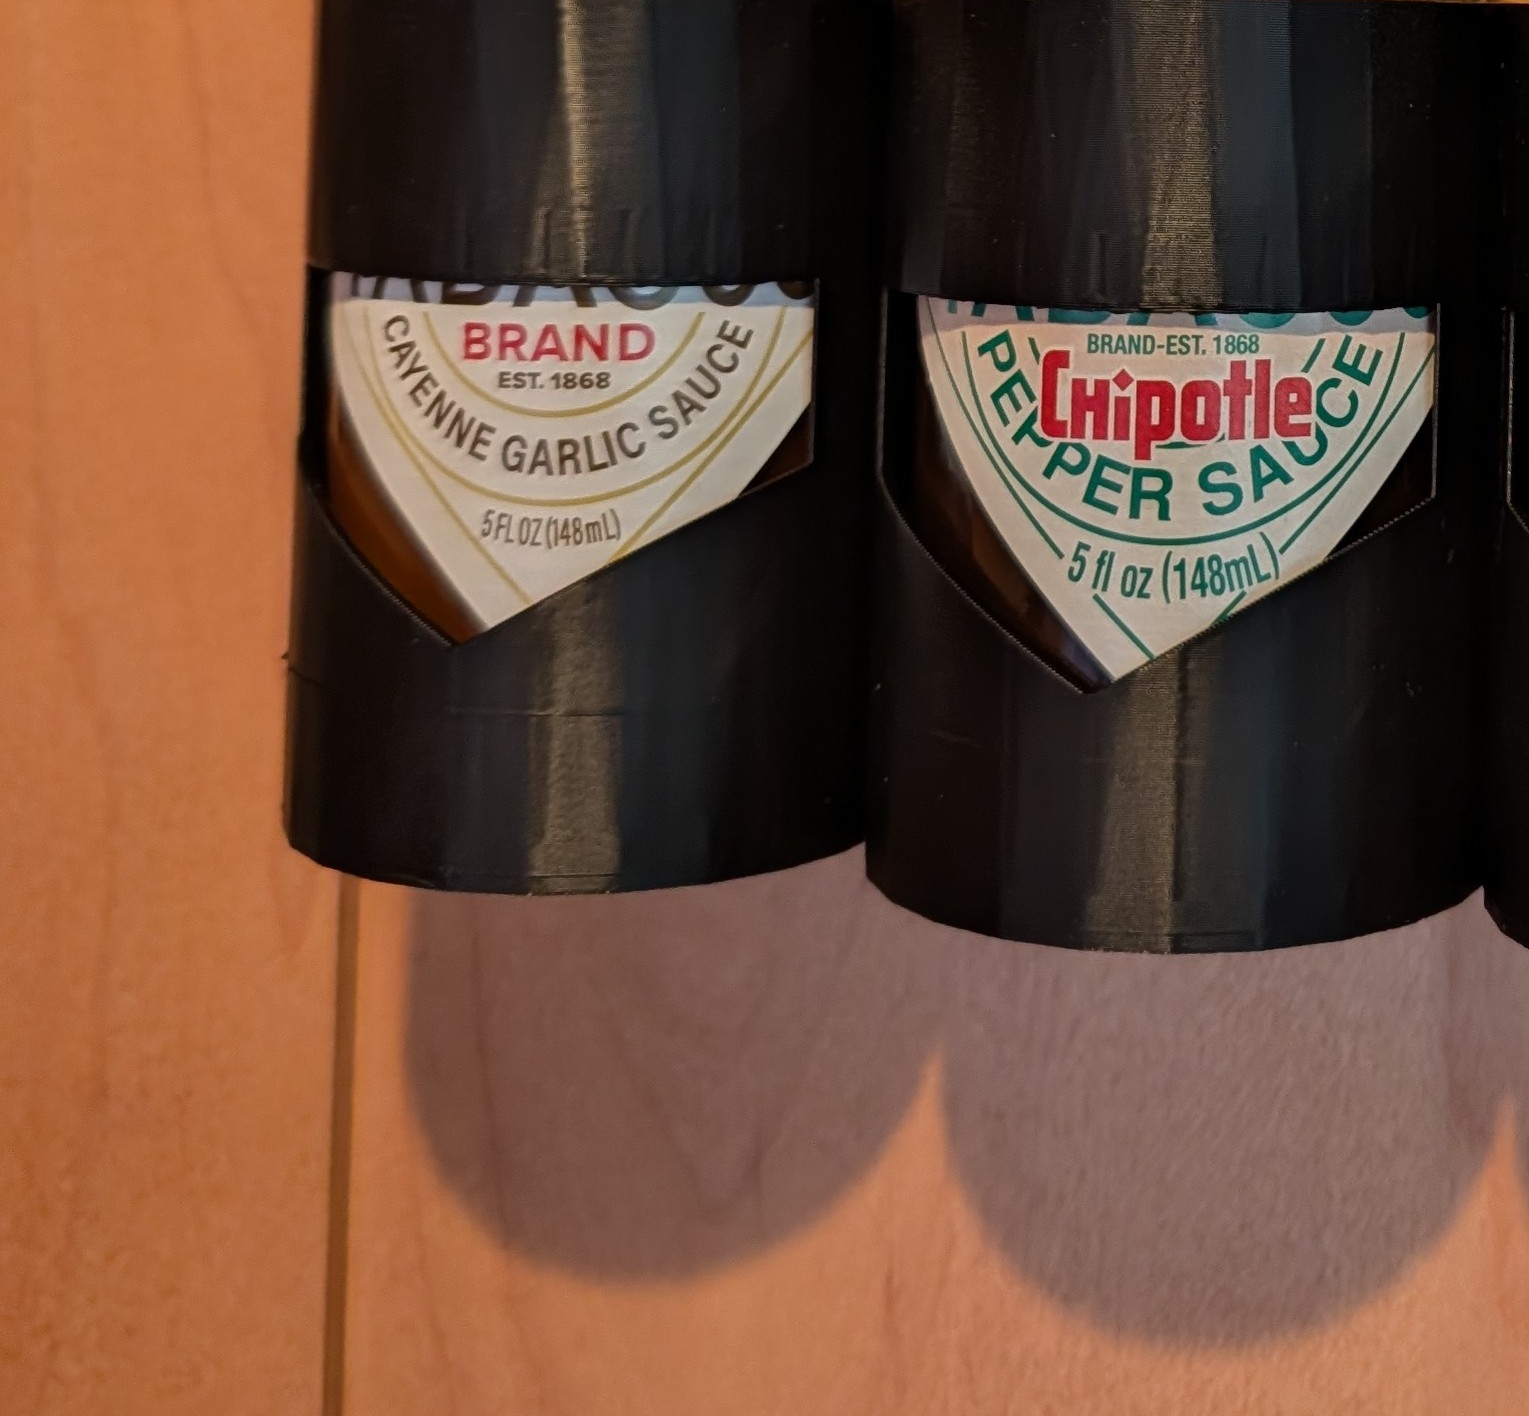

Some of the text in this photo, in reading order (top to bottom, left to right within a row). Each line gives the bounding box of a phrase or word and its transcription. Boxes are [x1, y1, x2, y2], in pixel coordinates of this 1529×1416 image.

[461, 322, 656, 363] BRAND
[1213, 332, 1260, 356] 1868
[383, 315, 755, 477] CAYENNE GARLIC SAUCE
[498, 370, 612, 391] EST. 1868
[1197, 333, 1385, 517] SAUCE
[1066, 531, 1283, 605] 5 fl oz (148mL)
